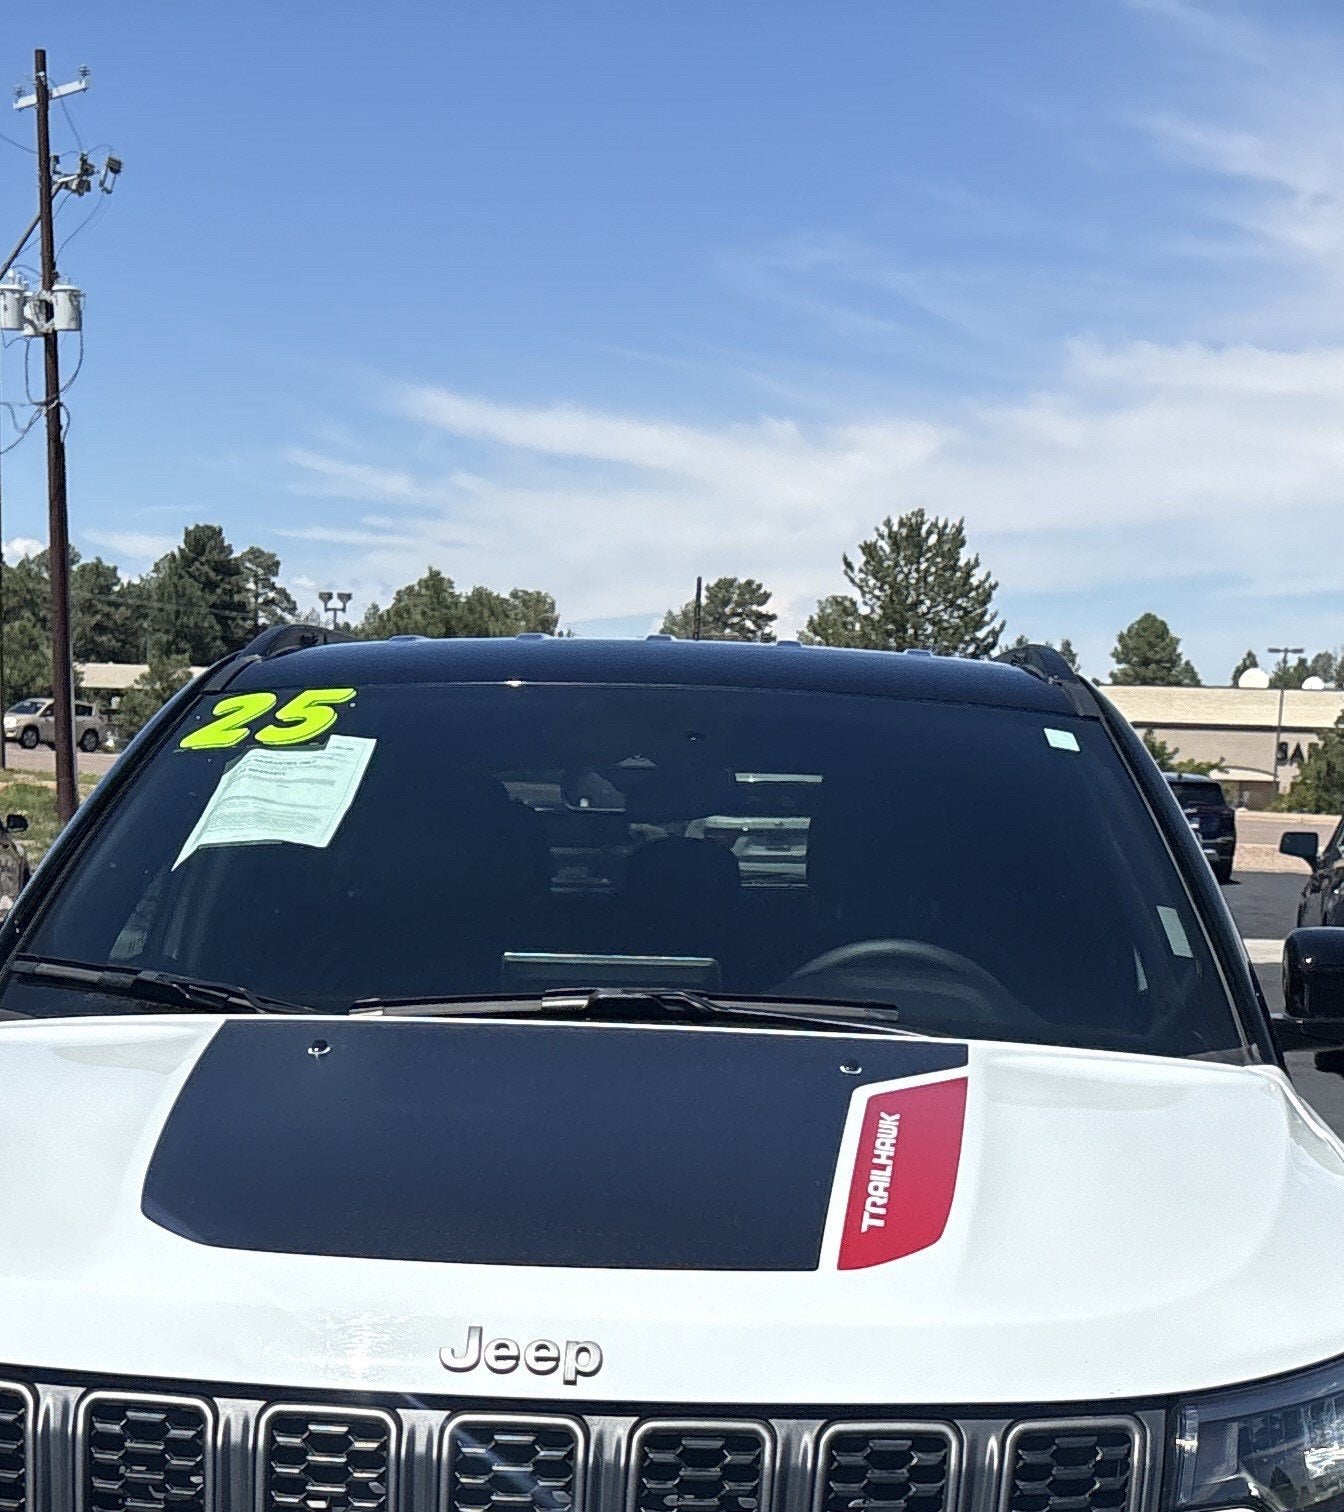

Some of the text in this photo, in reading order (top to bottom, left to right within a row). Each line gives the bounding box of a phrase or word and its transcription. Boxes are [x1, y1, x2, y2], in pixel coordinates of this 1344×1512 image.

[179, 687, 357, 749] 25
[860, 1111, 901, 1233] TRAILHAWK
[438, 1325, 604, 1387] Jeep
